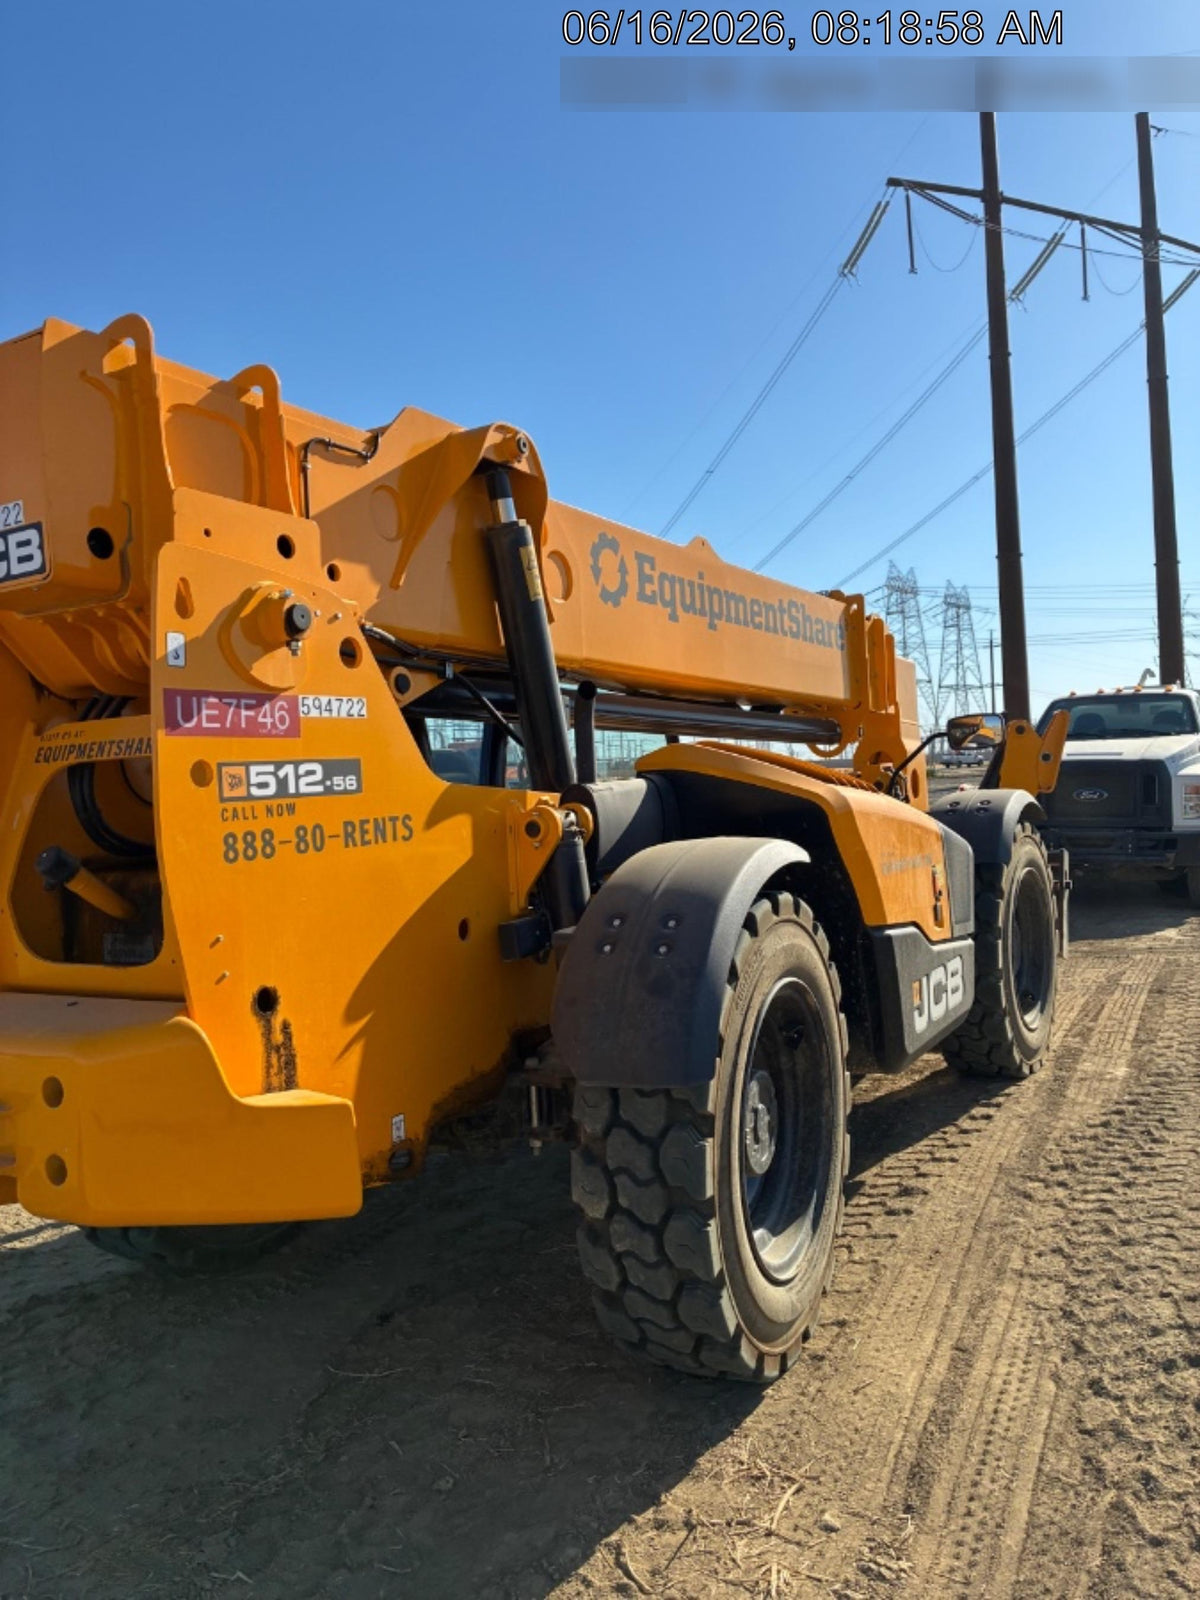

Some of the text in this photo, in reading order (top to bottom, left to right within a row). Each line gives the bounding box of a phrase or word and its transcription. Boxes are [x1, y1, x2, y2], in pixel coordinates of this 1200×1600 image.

[635, 552, 845, 652] EquipmentShare
[176, 696, 291, 730] UE7F46
[301, 697, 366, 717] 594722
[221, 803, 297, 822] CALL NOW
[222, 814, 414, 864] 888-80-RENTS
[912, 955, 964, 1034] JCB
